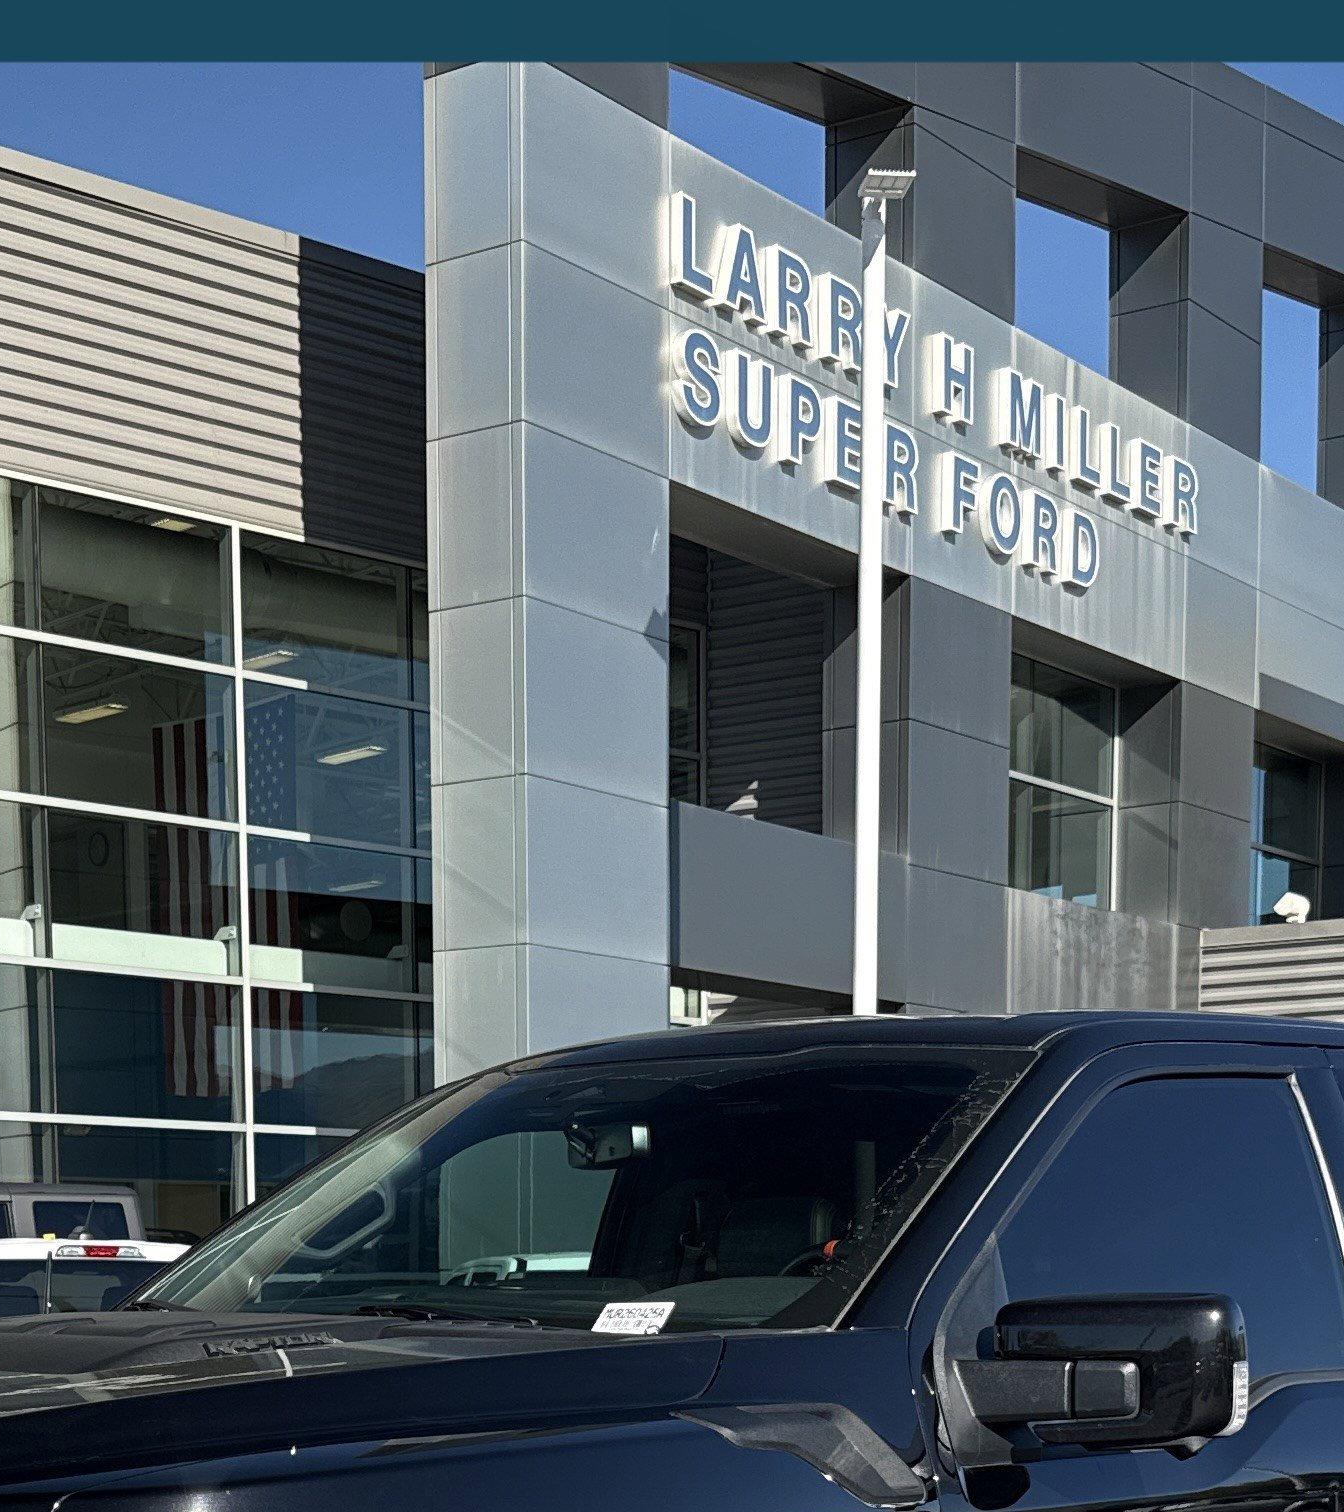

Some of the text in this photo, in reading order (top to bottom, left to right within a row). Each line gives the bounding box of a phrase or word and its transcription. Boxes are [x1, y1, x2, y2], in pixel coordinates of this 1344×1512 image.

[671, 191, 1199, 535] LARRY H MILLER
[673, 328, 1100, 588] SUPER FORD
